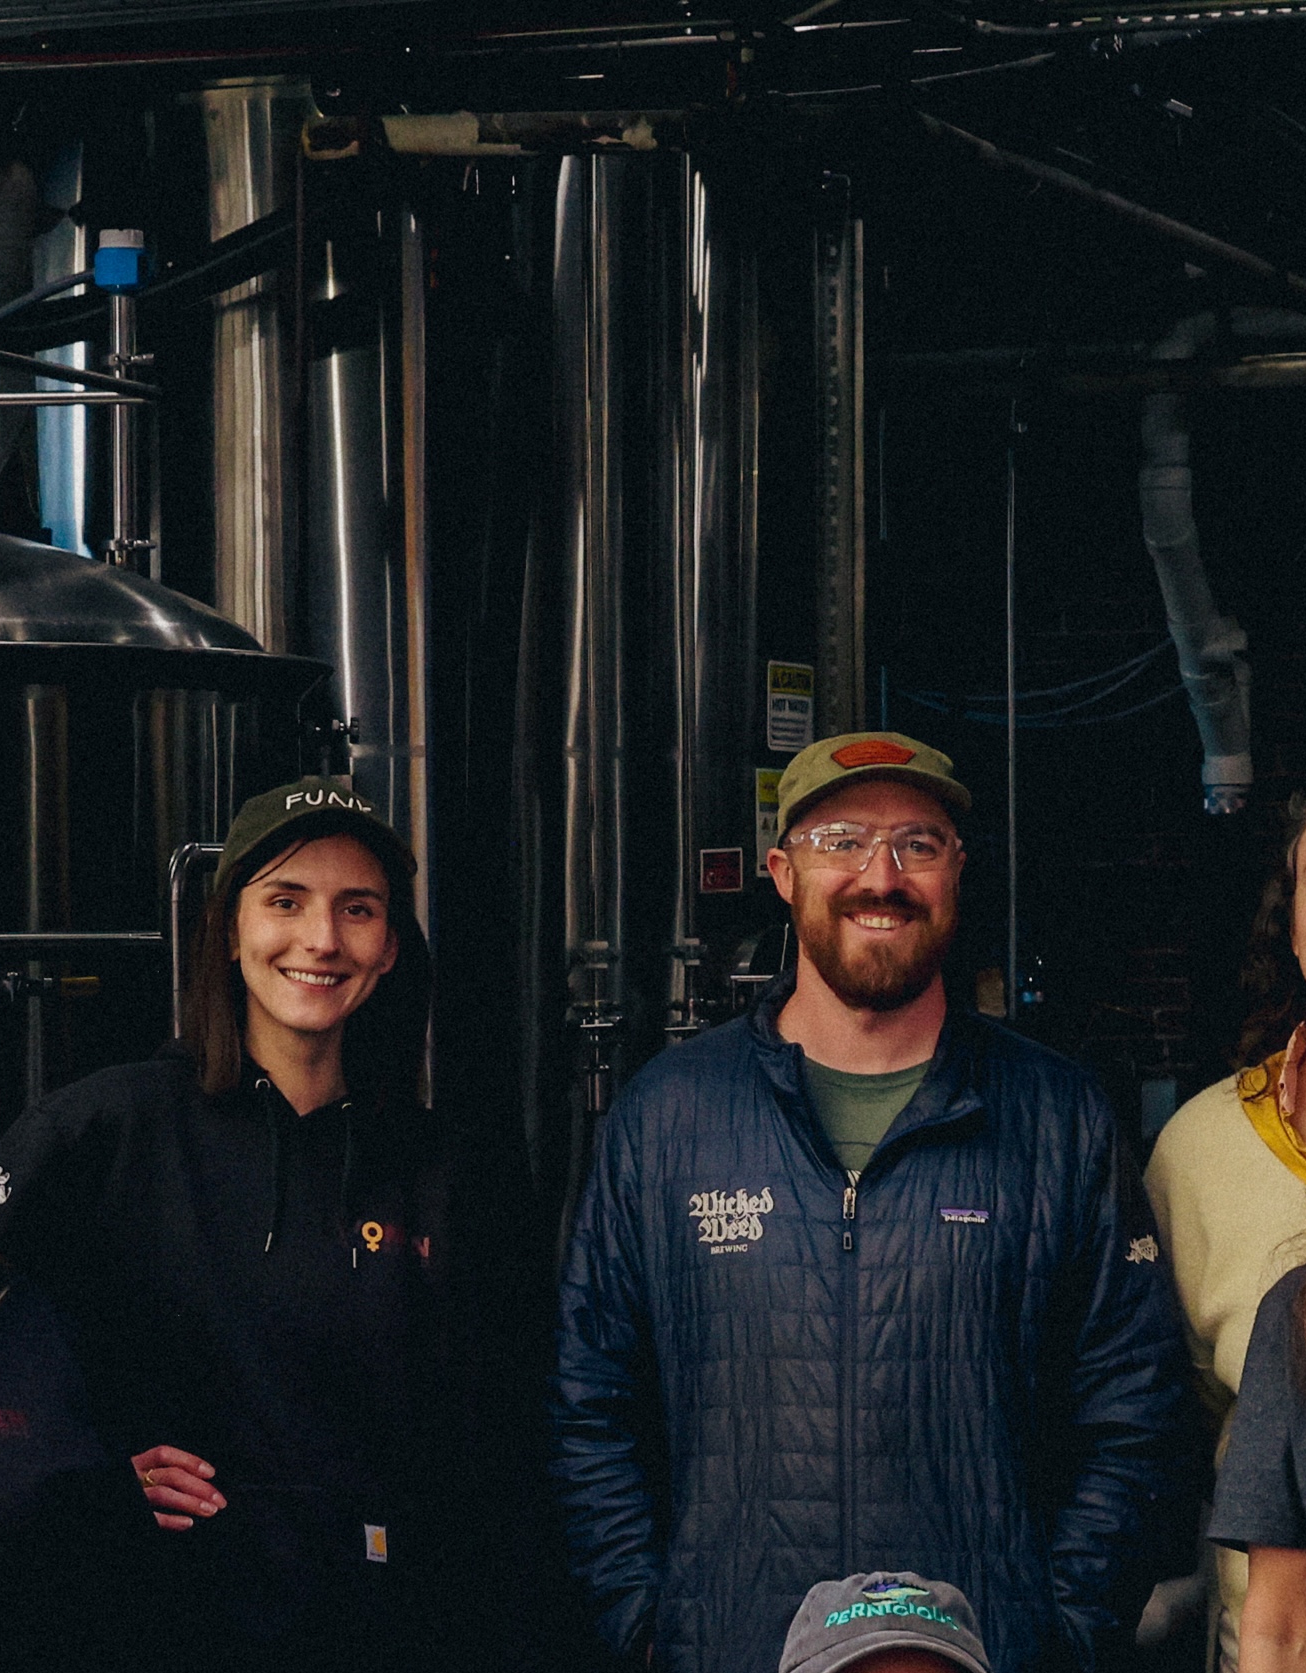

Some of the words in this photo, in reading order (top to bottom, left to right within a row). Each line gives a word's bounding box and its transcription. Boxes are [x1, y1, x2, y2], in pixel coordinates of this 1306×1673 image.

[688, 1186, 775, 1219] Wicked
[698, 1213, 764, 1243] Weed
[710, 1243, 749, 1255] BREWING
